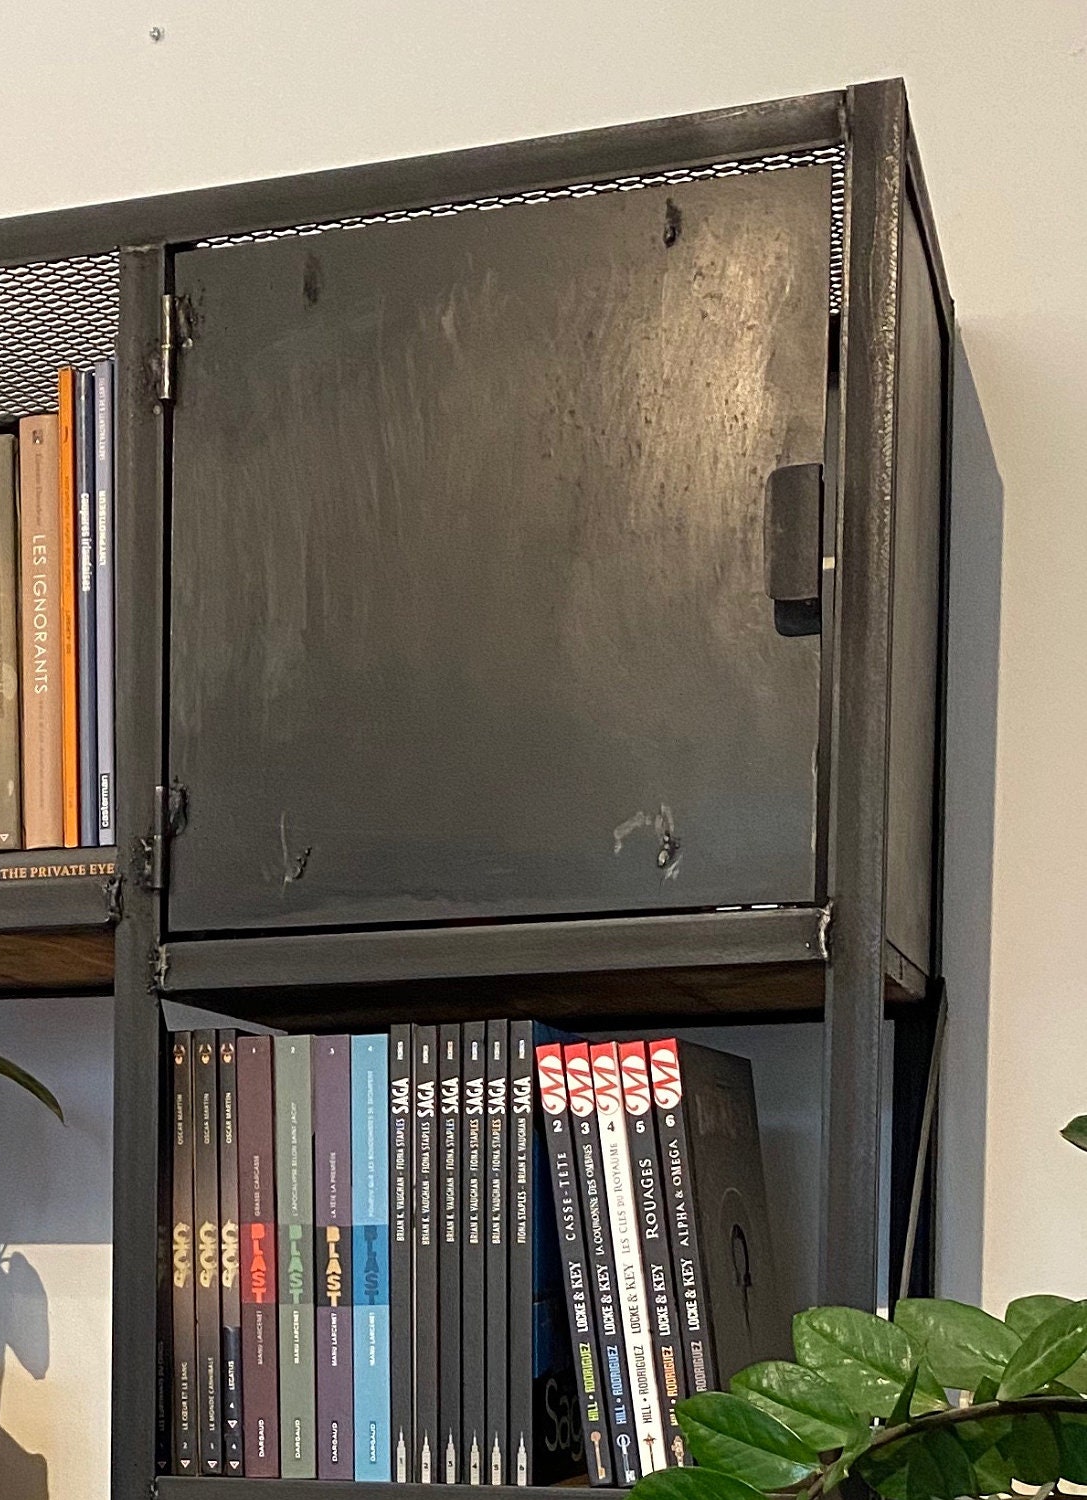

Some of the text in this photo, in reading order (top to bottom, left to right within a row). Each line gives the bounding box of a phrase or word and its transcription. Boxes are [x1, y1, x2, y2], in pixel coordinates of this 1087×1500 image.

[33, 534, 48, 566] LES
[34, 574, 48, 694] IGNORANTS
[100, 774, 110, 827] casterman
[0, 862, 116, 880] THE PRIVATE EYE
[392, 1078, 409, 1114] SAGA
[417, 1081, 435, 1118] SAGA
[441, 1077, 459, 1114] SAGA
[466, 1078, 484, 1115] SAGA
[488, 1078, 506, 1115] SAGA
[513, 1076, 531, 1114] SAGA
[396, 1118, 405, 1147] STAPLES
[421, 1121, 430, 1150] STAPLES
[492, 1119, 501, 1148] STAPLES
[517, 1118, 526, 1152] VAUGHAN
[553, 1120, 563, 1133] 2
[580, 1121, 590, 1135] 3
[607, 1120, 615, 1132] 4
[635, 1120, 645, 1134] 5
[665, 1115, 676, 1128] 6
[396, 1148, 405, 1170] FIONA
[421, 1152, 430, 1174] FIONA
[492, 1150, 501, 1171] FIONA
[517, 1162, 526, 1183] BRIAN
[396, 1177, 405, 1210] VAUGHAN
[421, 1181, 430, 1213] VAUGHAN
[492, 1178, 501, 1212] VAUGHAN
[517, 1191, 526, 1220] STAPLES
[556, 1152, 577, 1241] CASSE-TÊTE
[583, 1144, 604, 1256] LA COURONNE DES OMBRES
[639, 1159, 659, 1240] ROUAGES
[668, 1140, 690, 1247] ALPHA & OMEGA
[396, 1220, 405, 1241] BRIAN
[421, 1224, 430, 1245] BRIAN
[492, 1223, 501, 1244] BRIAN
[517, 1221, 526, 1243] FIONA
[251, 1224, 266, 1303] BLAST
[288, 1225, 303, 1304] BLAST
[326, 1226, 341, 1307] BLAST
[568, 1261, 588, 1333] LOCKE & KEY
[596, 1264, 616, 1336] LOCKE & KEY
[622, 1263, 641, 1334] LOCKE & KEY
[651, 1264, 671, 1336] LOCKE & KEY
[680, 1258, 701, 1331] LOCKE & KEY
[227, 1361, 235, 1391] LEGATUS
[579, 1342, 598, 1421] HILL RODRIGUEZ
[661, 1346, 678, 1397] RODRIGUEZ
[691, 1341, 707, 1392] RODRIGUEZ
[607, 1345, 626, 1425] HILL RODRIGUEZ
[634, 1346, 652, 1424] HILL RODRIGUEZ
